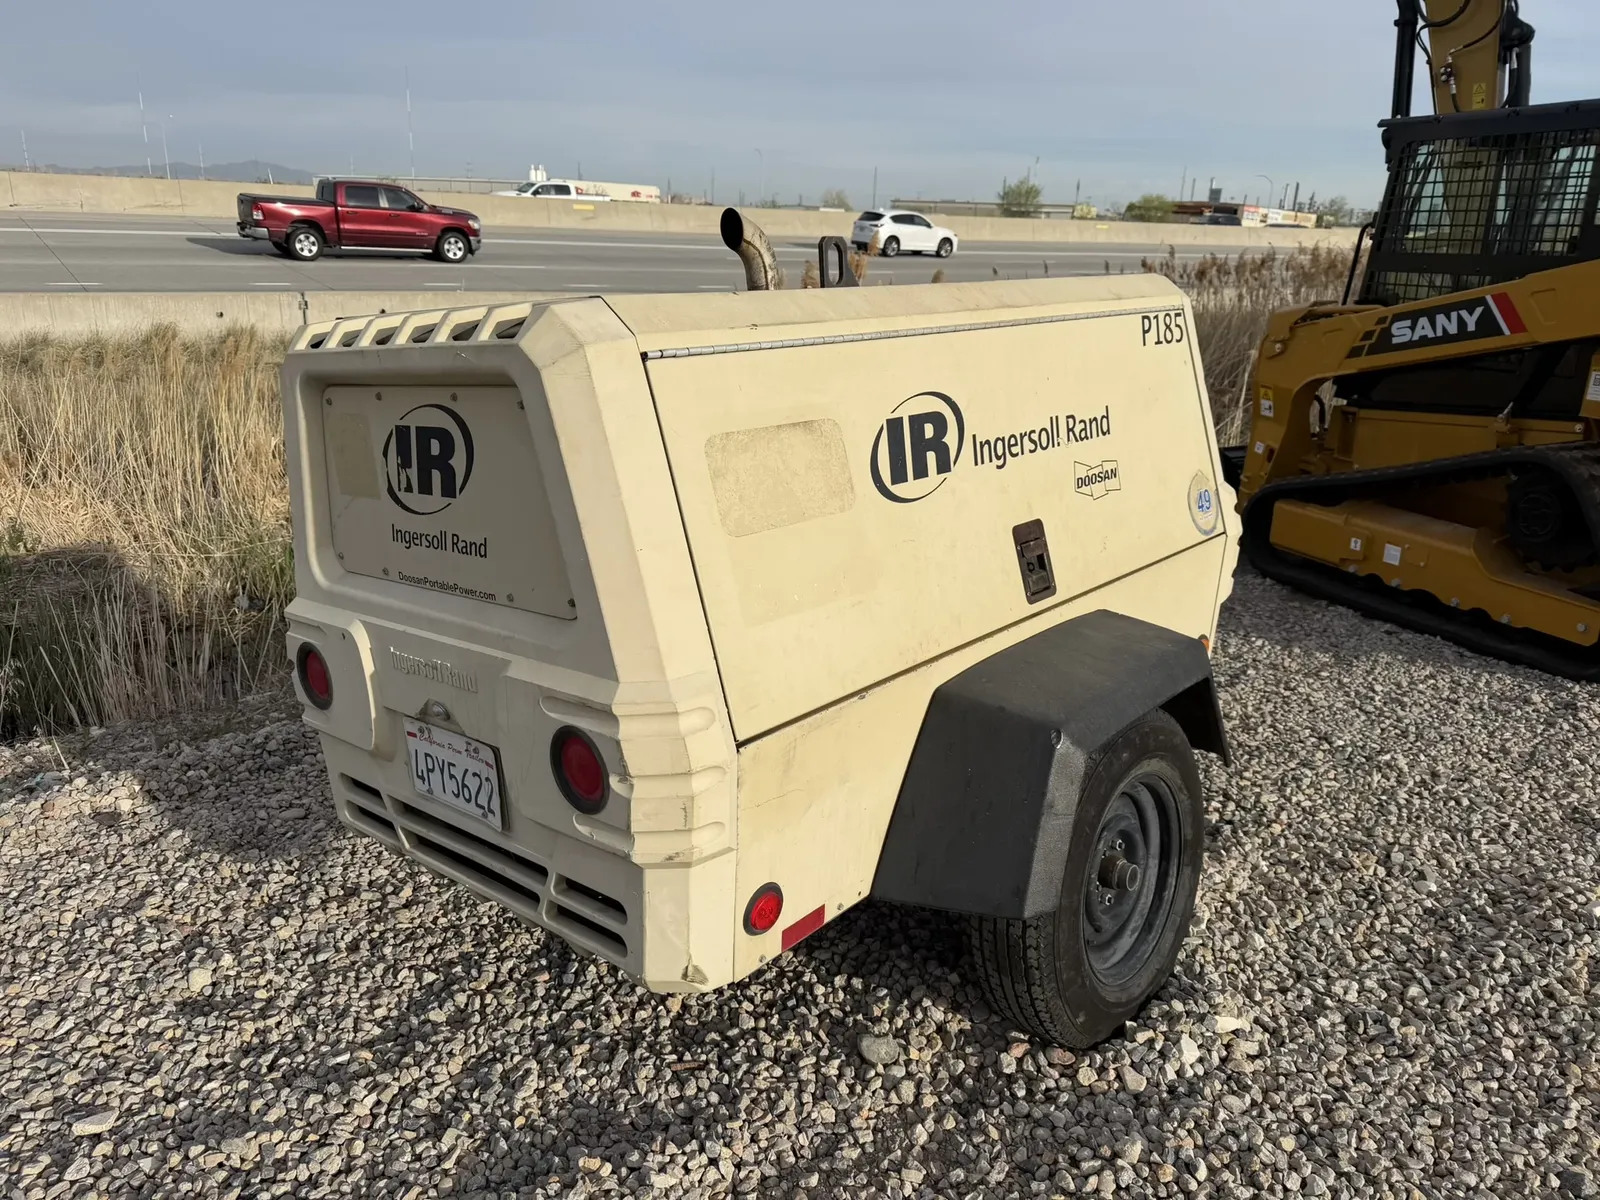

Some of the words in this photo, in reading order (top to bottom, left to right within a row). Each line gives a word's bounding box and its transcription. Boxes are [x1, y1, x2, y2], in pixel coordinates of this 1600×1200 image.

[1141, 312, 1184, 347] P185
[1391, 305, 1485, 345] SANY
[885, 410, 952, 486] IR
[972, 415, 1061, 470] Ingersoll
[1066, 405, 1112, 446] Rand
[394, 424, 458, 500] IR
[1076, 467, 1117, 489] DOOSAN
[1197, 489, 1211, 512] 49
[391, 523, 448, 552] Ingersoll
[451, 533, 488, 558] Rand
[398, 571, 496, 601] DoosanPortablePower.com
[414, 748, 496, 818] 4PY5622
